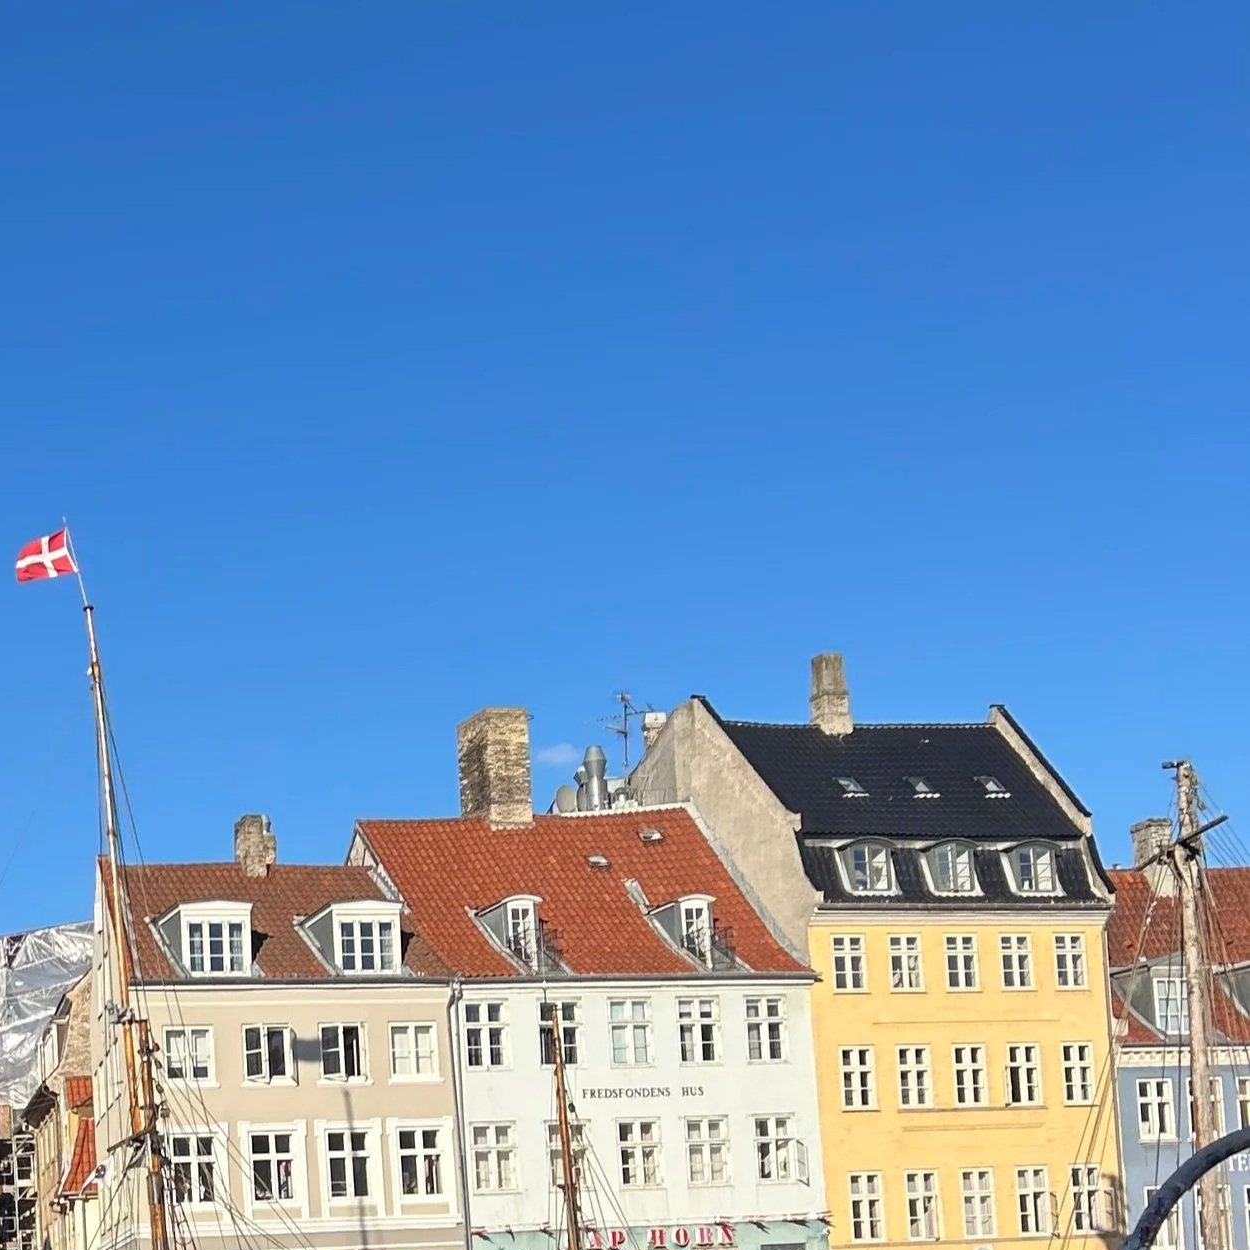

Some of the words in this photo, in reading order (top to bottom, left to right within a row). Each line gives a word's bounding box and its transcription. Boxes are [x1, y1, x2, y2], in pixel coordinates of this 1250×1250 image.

[582, 1087, 671, 1099] FREDSFONDENS
[681, 1085, 704, 1097] HUS
[647, 1224, 735, 1249] HORN
